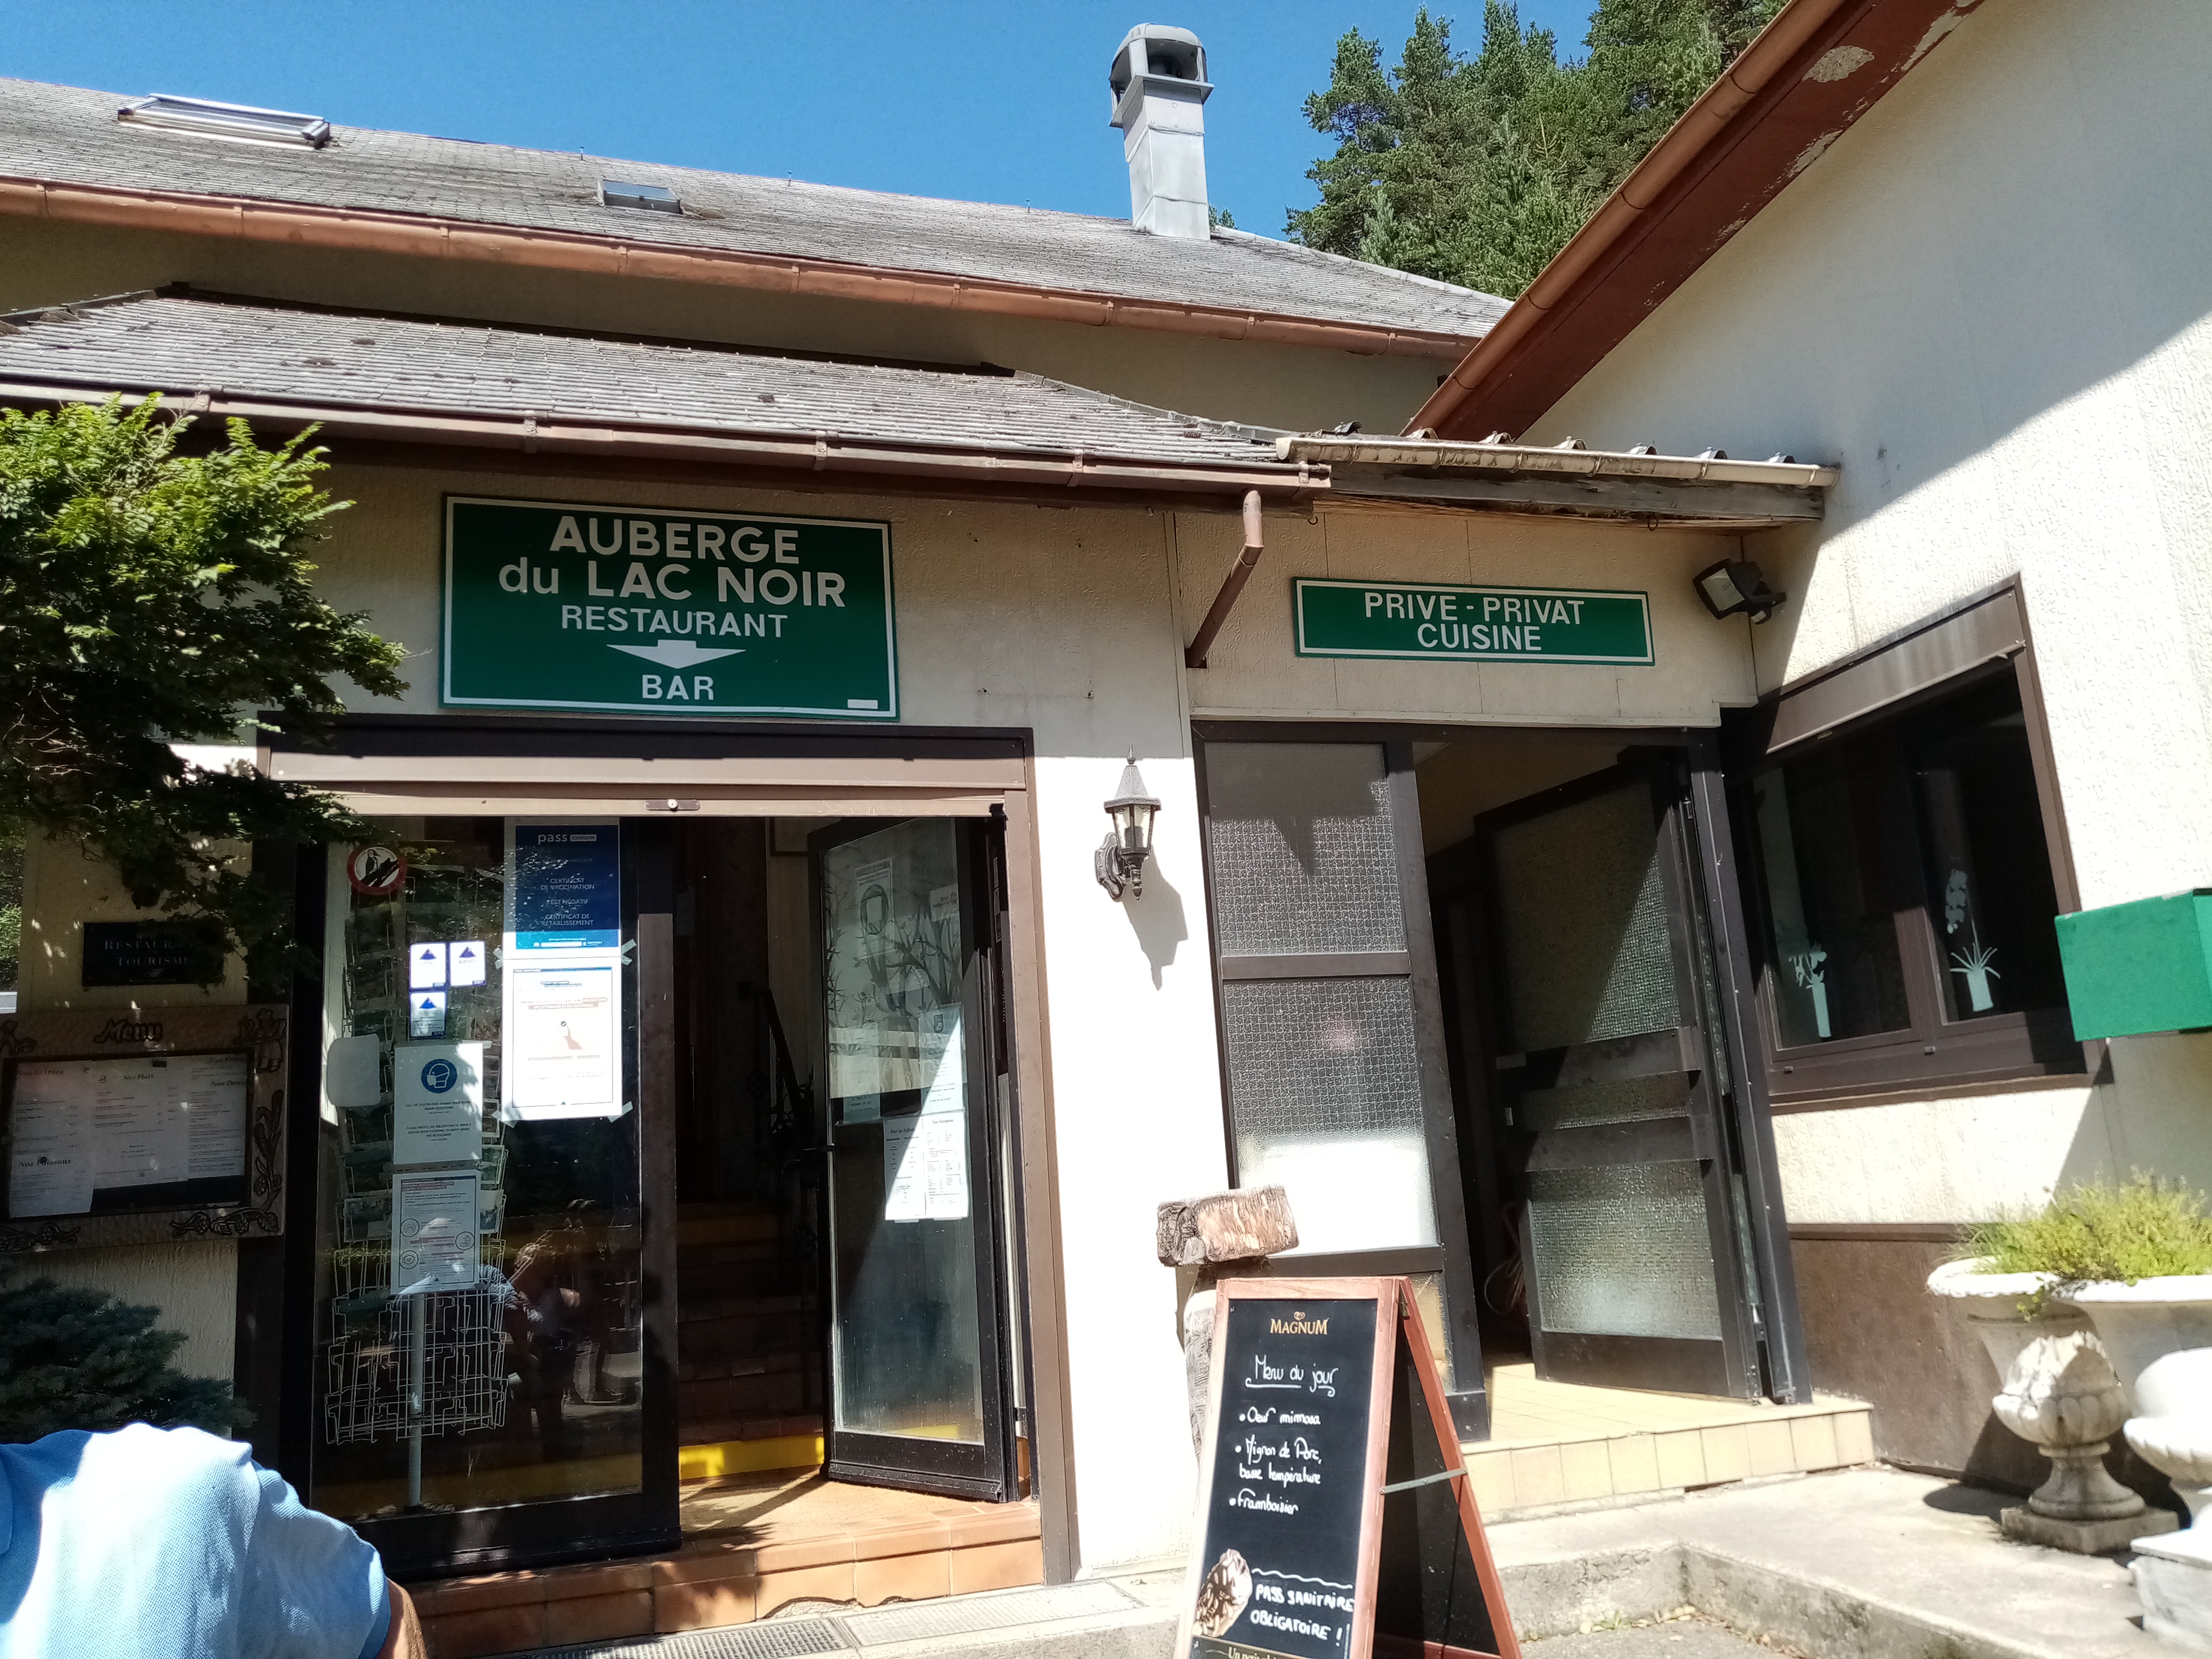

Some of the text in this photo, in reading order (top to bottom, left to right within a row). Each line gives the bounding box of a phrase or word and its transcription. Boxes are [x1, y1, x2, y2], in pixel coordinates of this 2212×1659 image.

[549, 515, 800, 564] AUBERGE
[498, 557, 845, 607] du LAC NOIR
[562, 606, 788, 638] RESTAURANT
[1364, 592, 1457, 621] PRIVE
[1482, 597, 1585, 625] PRIVAT
[1417, 623, 1541, 651] CUISINE
[642, 675, 714, 701] BAR
[538, 834, 567, 845] pass
[93, 1018, 163, 1044] Menu
[1270, 1318, 1328, 1336] MAGNUM
[1255, 1354, 1338, 1392] Menu du jour
[1280, 1411, 1321, 1425] mimosa
[1245, 1434, 1276, 1465] Mignon
[1279, 1441, 1290, 1458] de
[1239, 1462, 1263, 1480] basse
[1238, 1488, 1298, 1515] Framboisier
[1255, 1584, 1285, 1604] PASS
